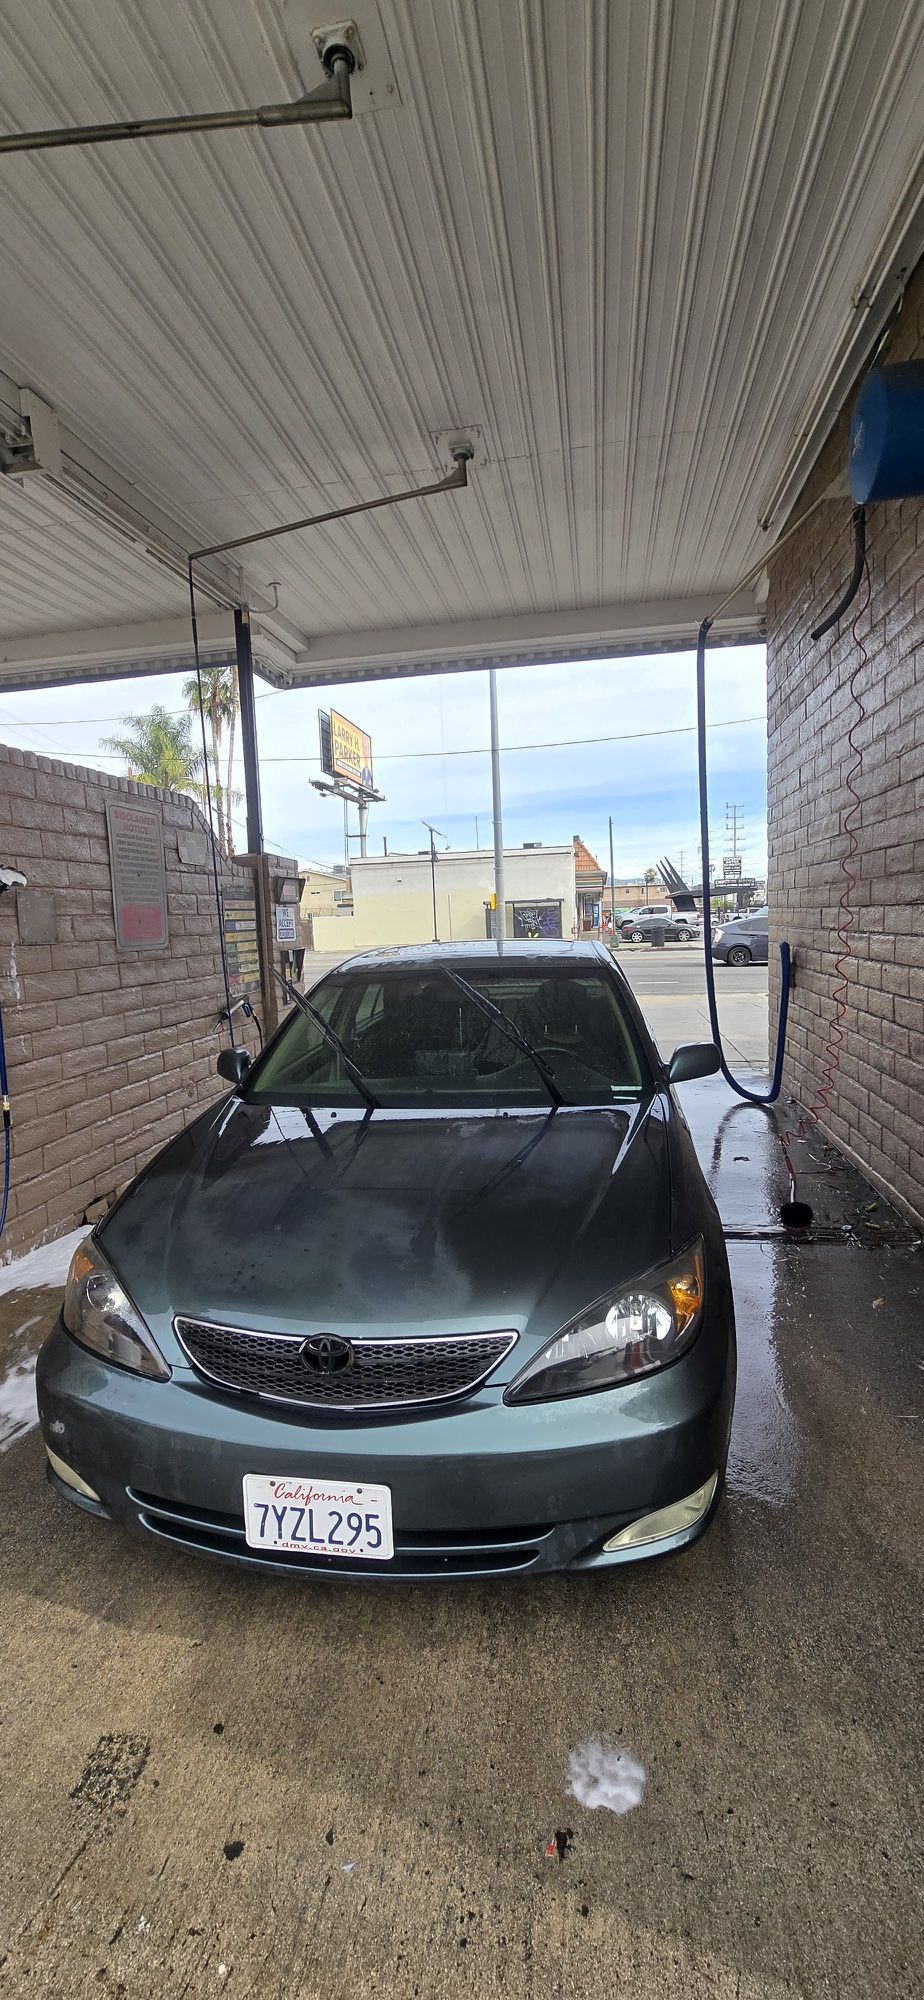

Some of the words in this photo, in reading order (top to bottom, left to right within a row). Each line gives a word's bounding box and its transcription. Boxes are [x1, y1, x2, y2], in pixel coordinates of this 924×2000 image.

[333, 721, 353, 747] LARRY
[334, 739, 361, 768] PARKER
[114, 810, 155, 826] DISCLAIMER
[123, 823, 150, 835] NOTICE
[281, 908, 289, 917] WE
[279, 918, 294, 928] ACCEPT
[273, 1482, 364, 1506] California
[254, 1503, 382, 1549] 7YZL295
[281, 1541, 356, 1555] dmv.ca.gov
